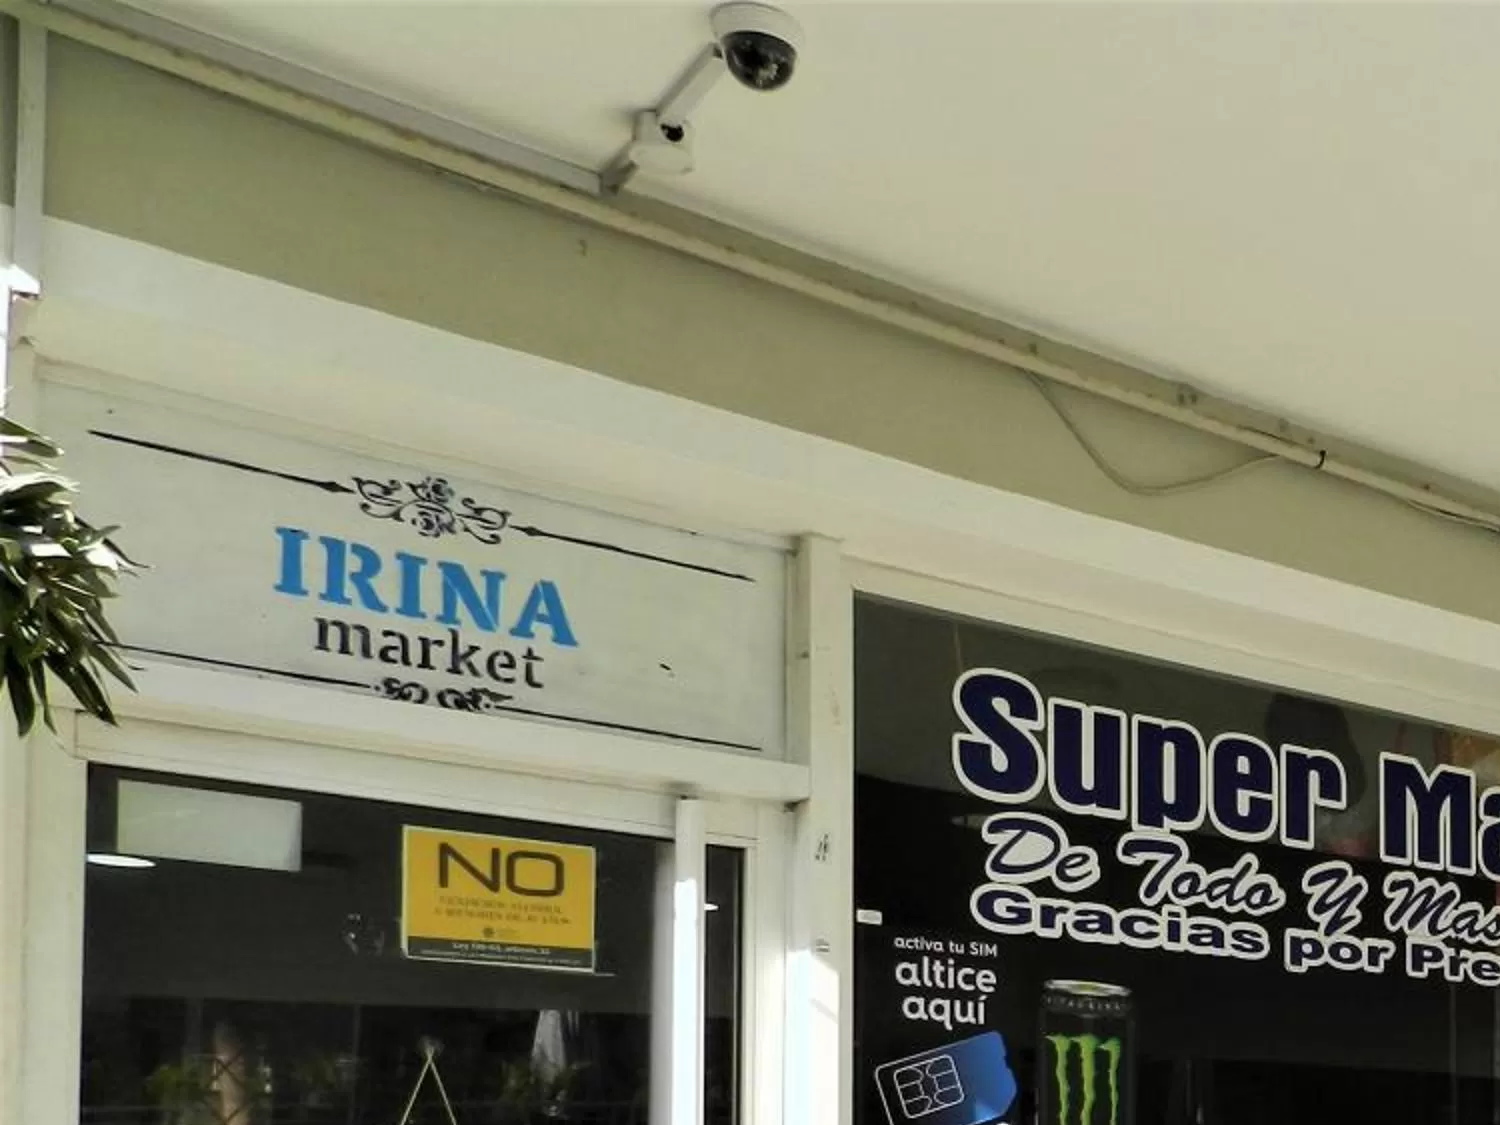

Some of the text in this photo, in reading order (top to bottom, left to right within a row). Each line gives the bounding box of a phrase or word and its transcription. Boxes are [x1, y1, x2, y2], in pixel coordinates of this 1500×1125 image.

[273, 526, 579, 648] IRINA
[312, 616, 547, 690] market
[952, 667, 1347, 850] Super
[438, 842, 565, 898] NO
[982, 811, 1100, 893] De
[1116, 832, 1286, 916] Todo
[1302, 861, 1369, 937] Y
[893, 937, 998, 957] activa tu SIM
[970, 882, 1270, 960] Gracias
[1284, 927, 1396, 973] por
[894, 955, 998, 993] altice
[901, 994, 988, 1031] aquí
